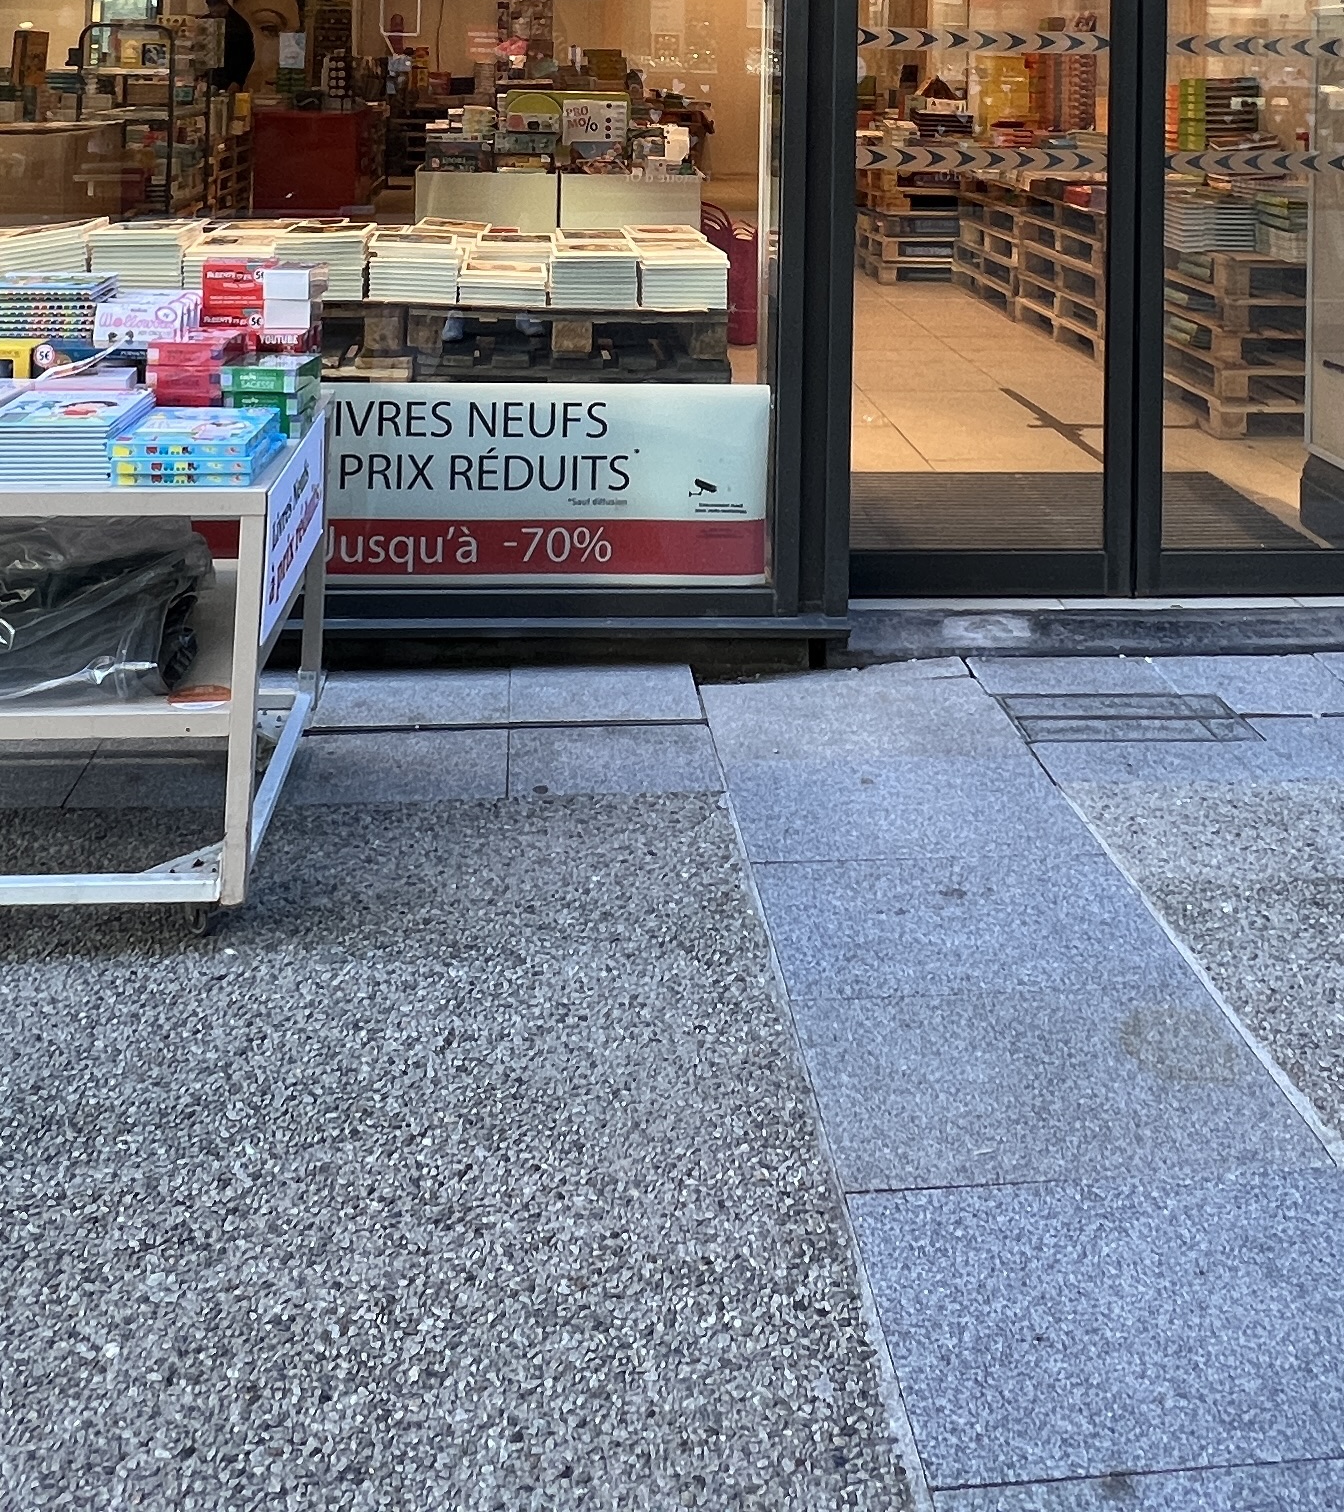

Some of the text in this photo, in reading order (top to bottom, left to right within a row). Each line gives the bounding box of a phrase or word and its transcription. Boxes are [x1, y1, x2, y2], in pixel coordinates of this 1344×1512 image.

[39, 351, 50, 361] 5€
[259, 334, 299, 345] YOUTUBE
[335, 399, 609, 439] IVRES NEUFS
[339, 453, 437, 492] PRIX
[325, 525, 613, 573] Jusqu'à -70%
